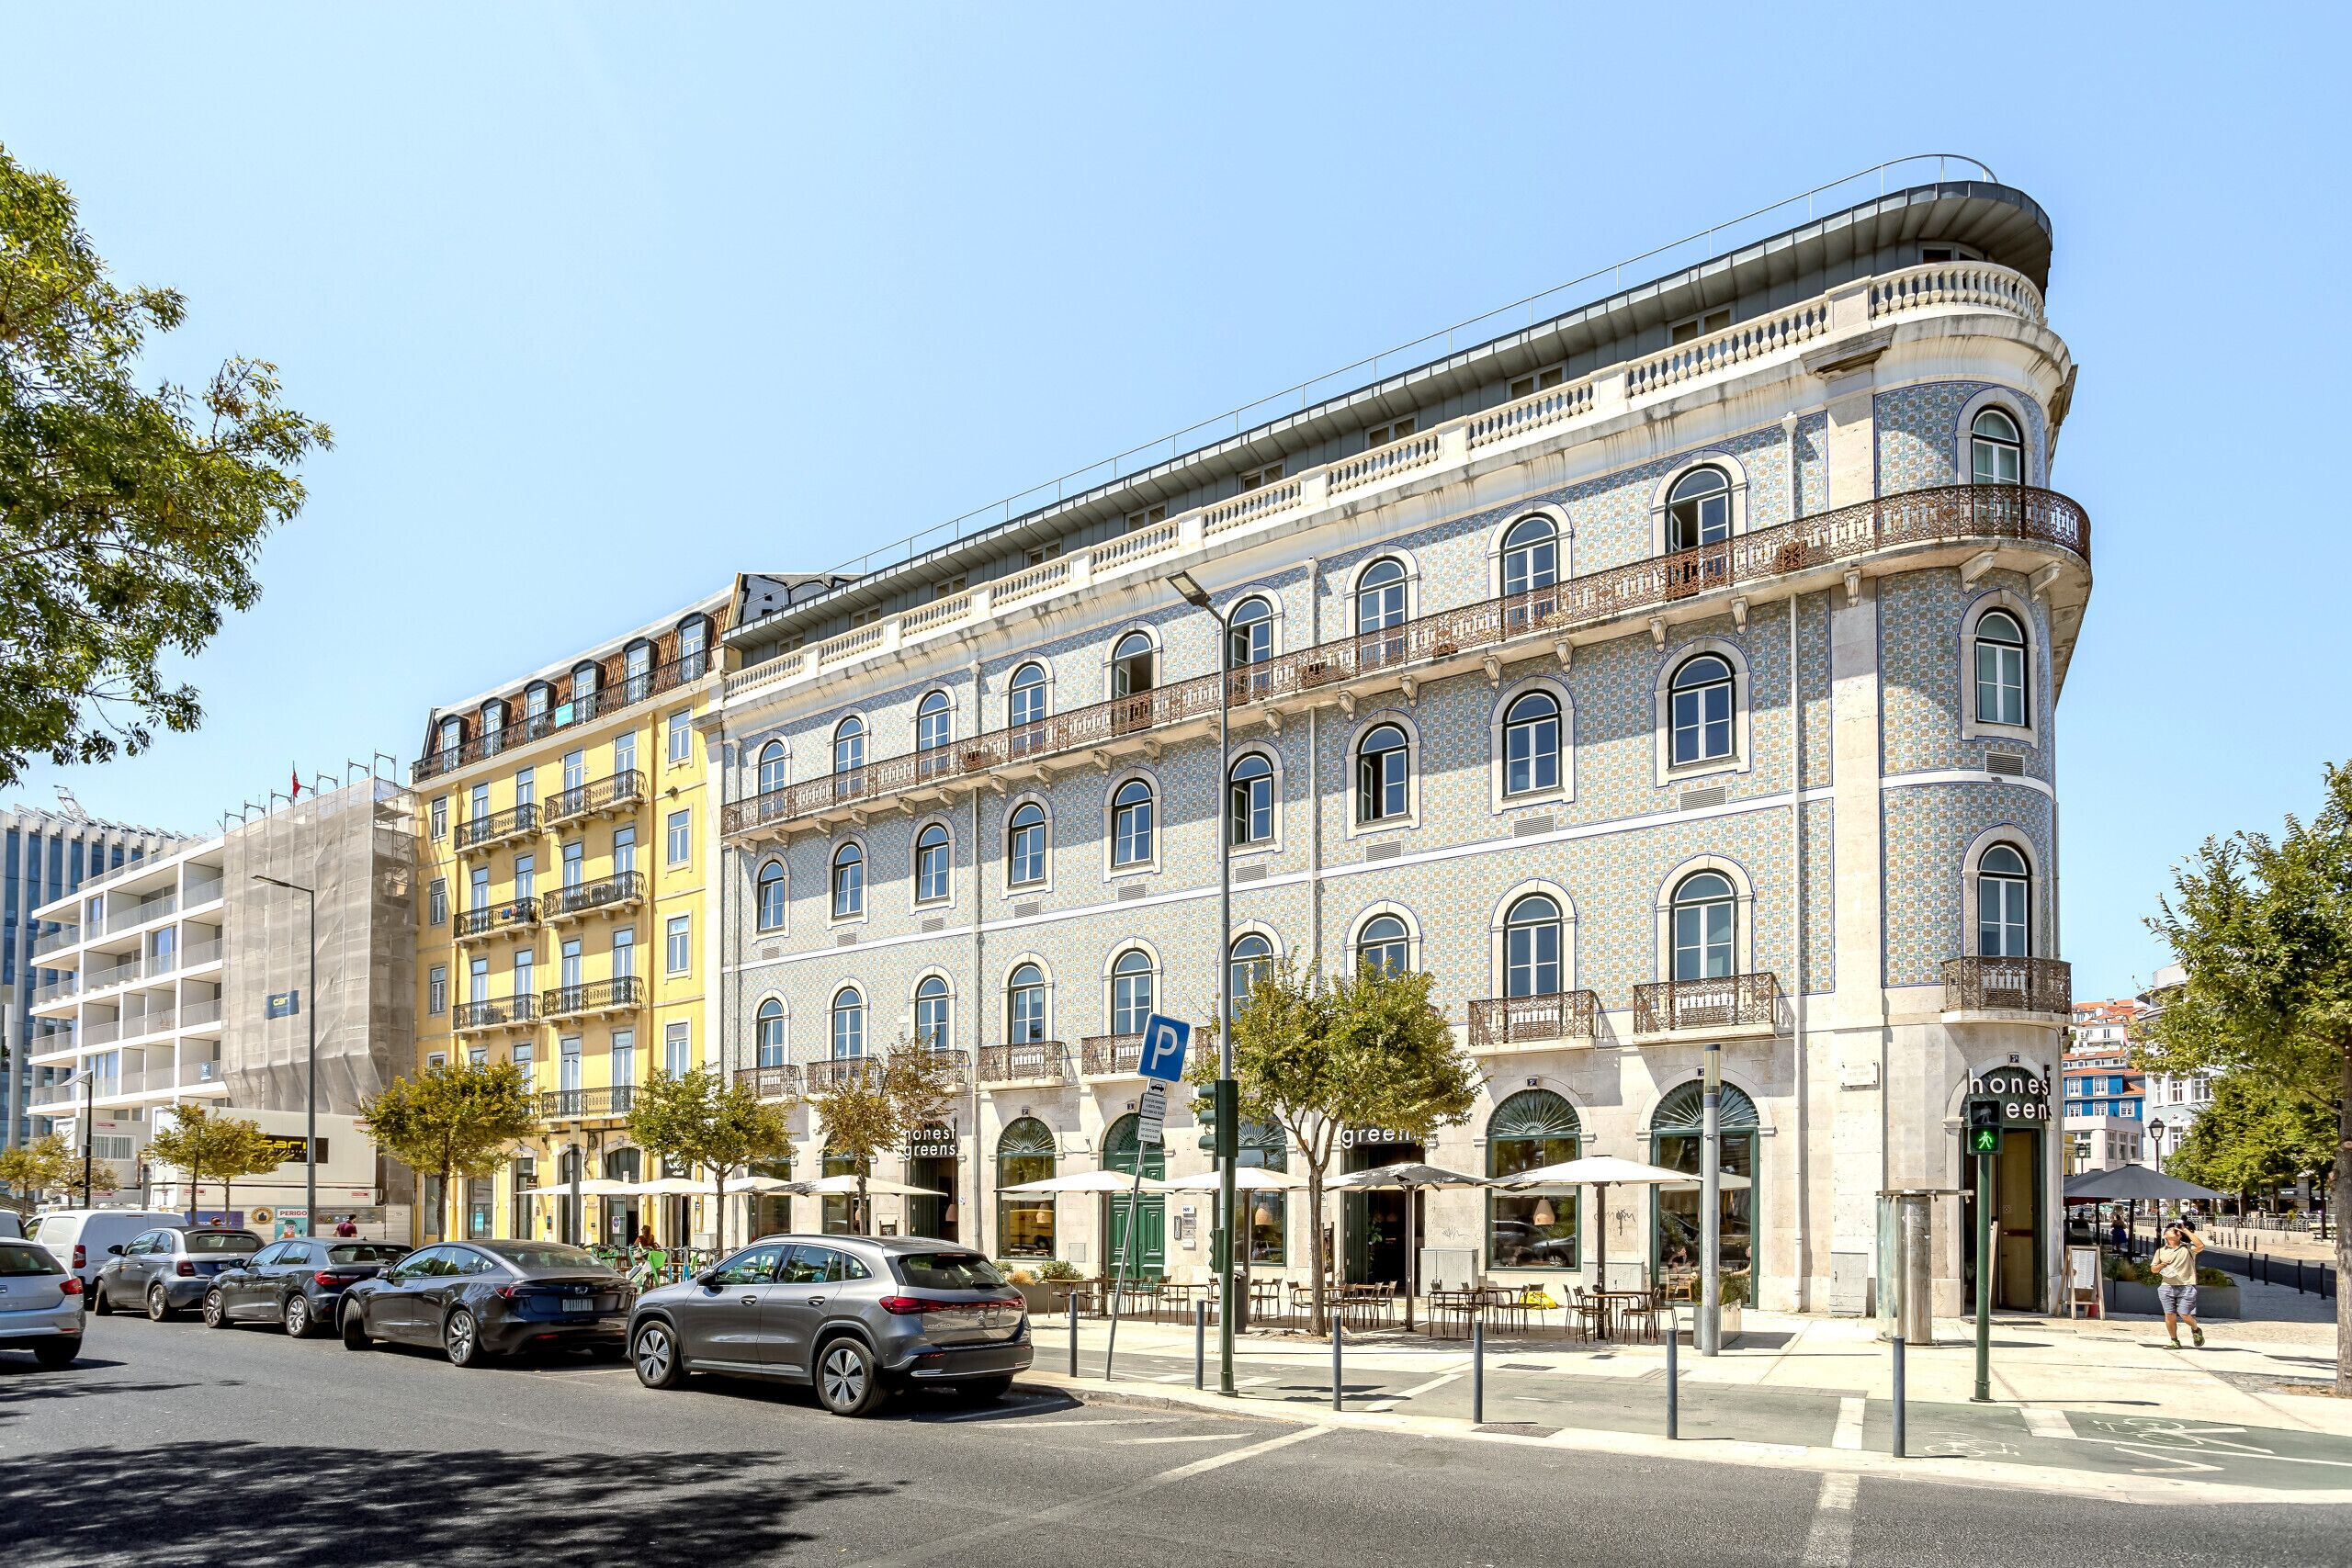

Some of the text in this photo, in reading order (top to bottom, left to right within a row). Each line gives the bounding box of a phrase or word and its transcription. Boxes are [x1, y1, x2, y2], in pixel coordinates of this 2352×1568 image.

[1150, 1023, 1178, 1070] P
[1968, 1066, 2051, 1096] hones
[1341, 1127, 1420, 1149] green
[904, 1144, 956, 1161] greens
